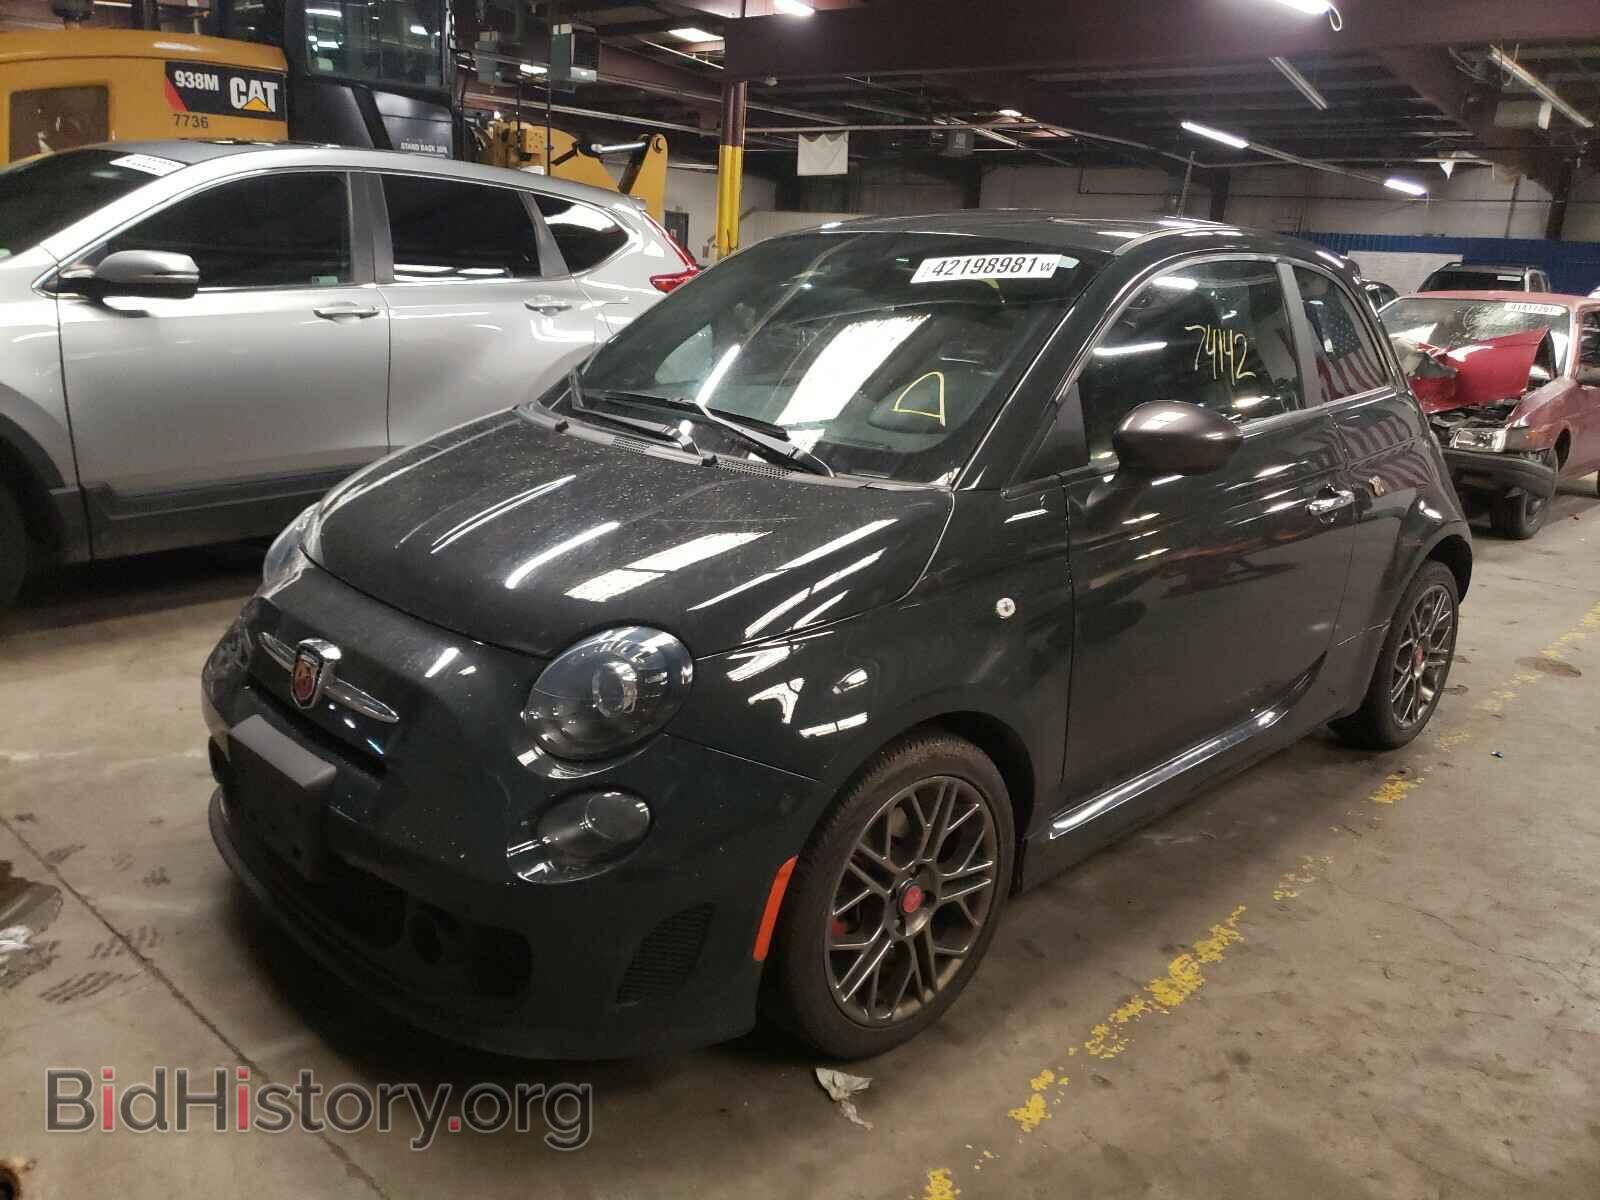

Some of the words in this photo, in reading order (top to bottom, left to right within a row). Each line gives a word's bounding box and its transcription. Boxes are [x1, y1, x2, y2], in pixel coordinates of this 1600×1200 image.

[174, 70, 220, 92] 938M
[229, 76, 278, 113] CAT
[173, 113, 209, 129] 7736
[1184, 324, 1257, 386] 74142
